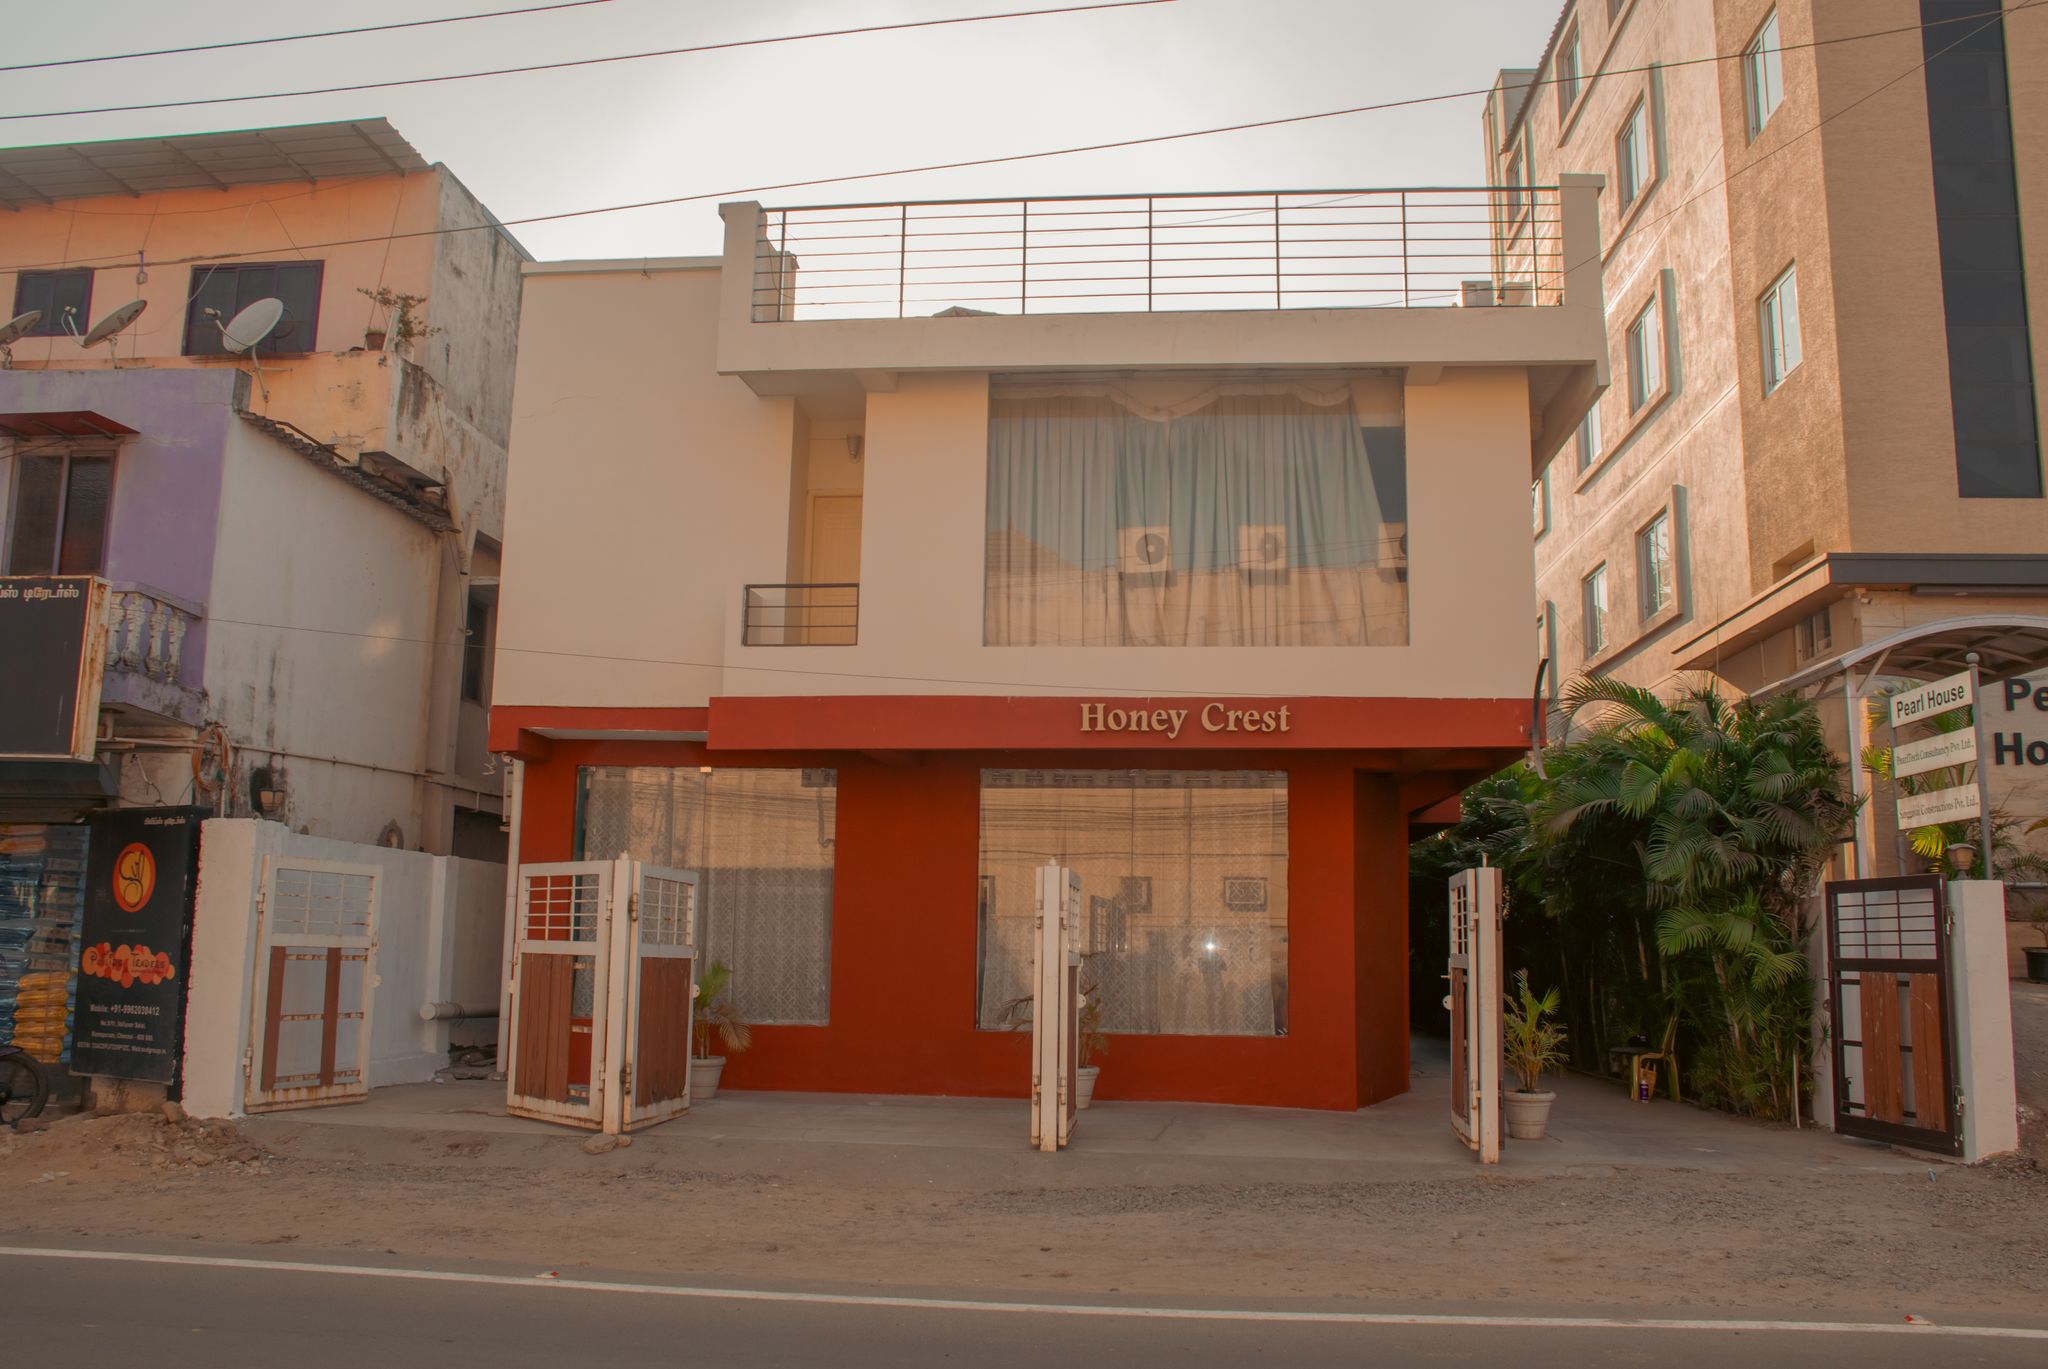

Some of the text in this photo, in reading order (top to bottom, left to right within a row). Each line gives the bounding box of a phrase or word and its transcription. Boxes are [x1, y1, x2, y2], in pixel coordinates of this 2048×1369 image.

[1896, 685, 1965, 719] Pearl House
[1080, 702, 1291, 739] Honey Crest
